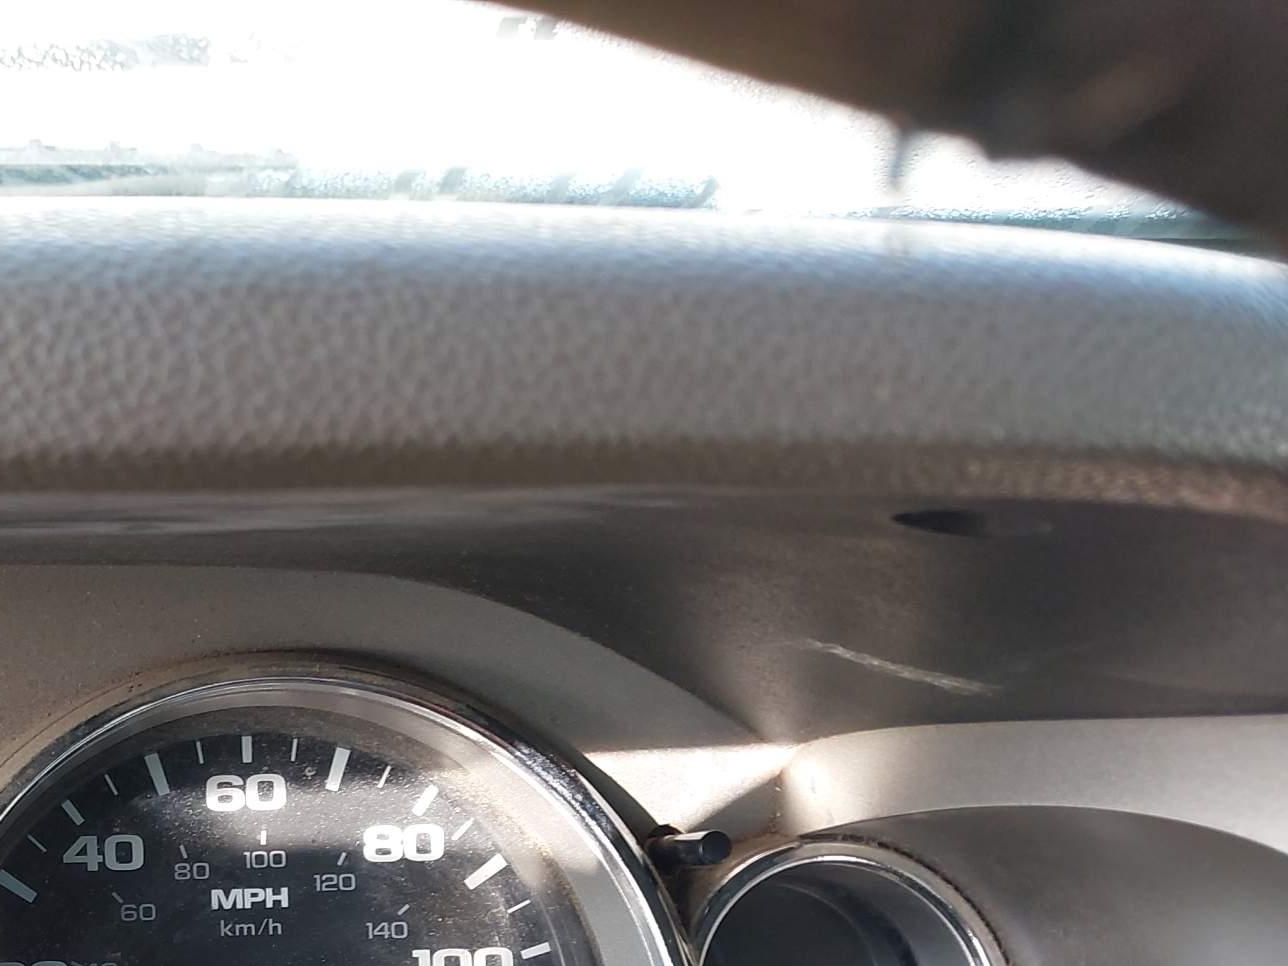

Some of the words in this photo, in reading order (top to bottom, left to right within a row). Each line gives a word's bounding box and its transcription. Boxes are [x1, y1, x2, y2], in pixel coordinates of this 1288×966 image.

[205, 773, 287, 811] 60
[362, 823, 445, 863] 80
[63, 834, 145, 872] 40
[243, 850, 287, 869] 100
[174, 862, 210, 881] 80
[313, 873, 357, 892] 120
[211, 887, 289, 910] MPH
[120, 904, 157, 922] 60
[219, 918, 282, 937] km/h
[365, 922, 409, 940] 140
